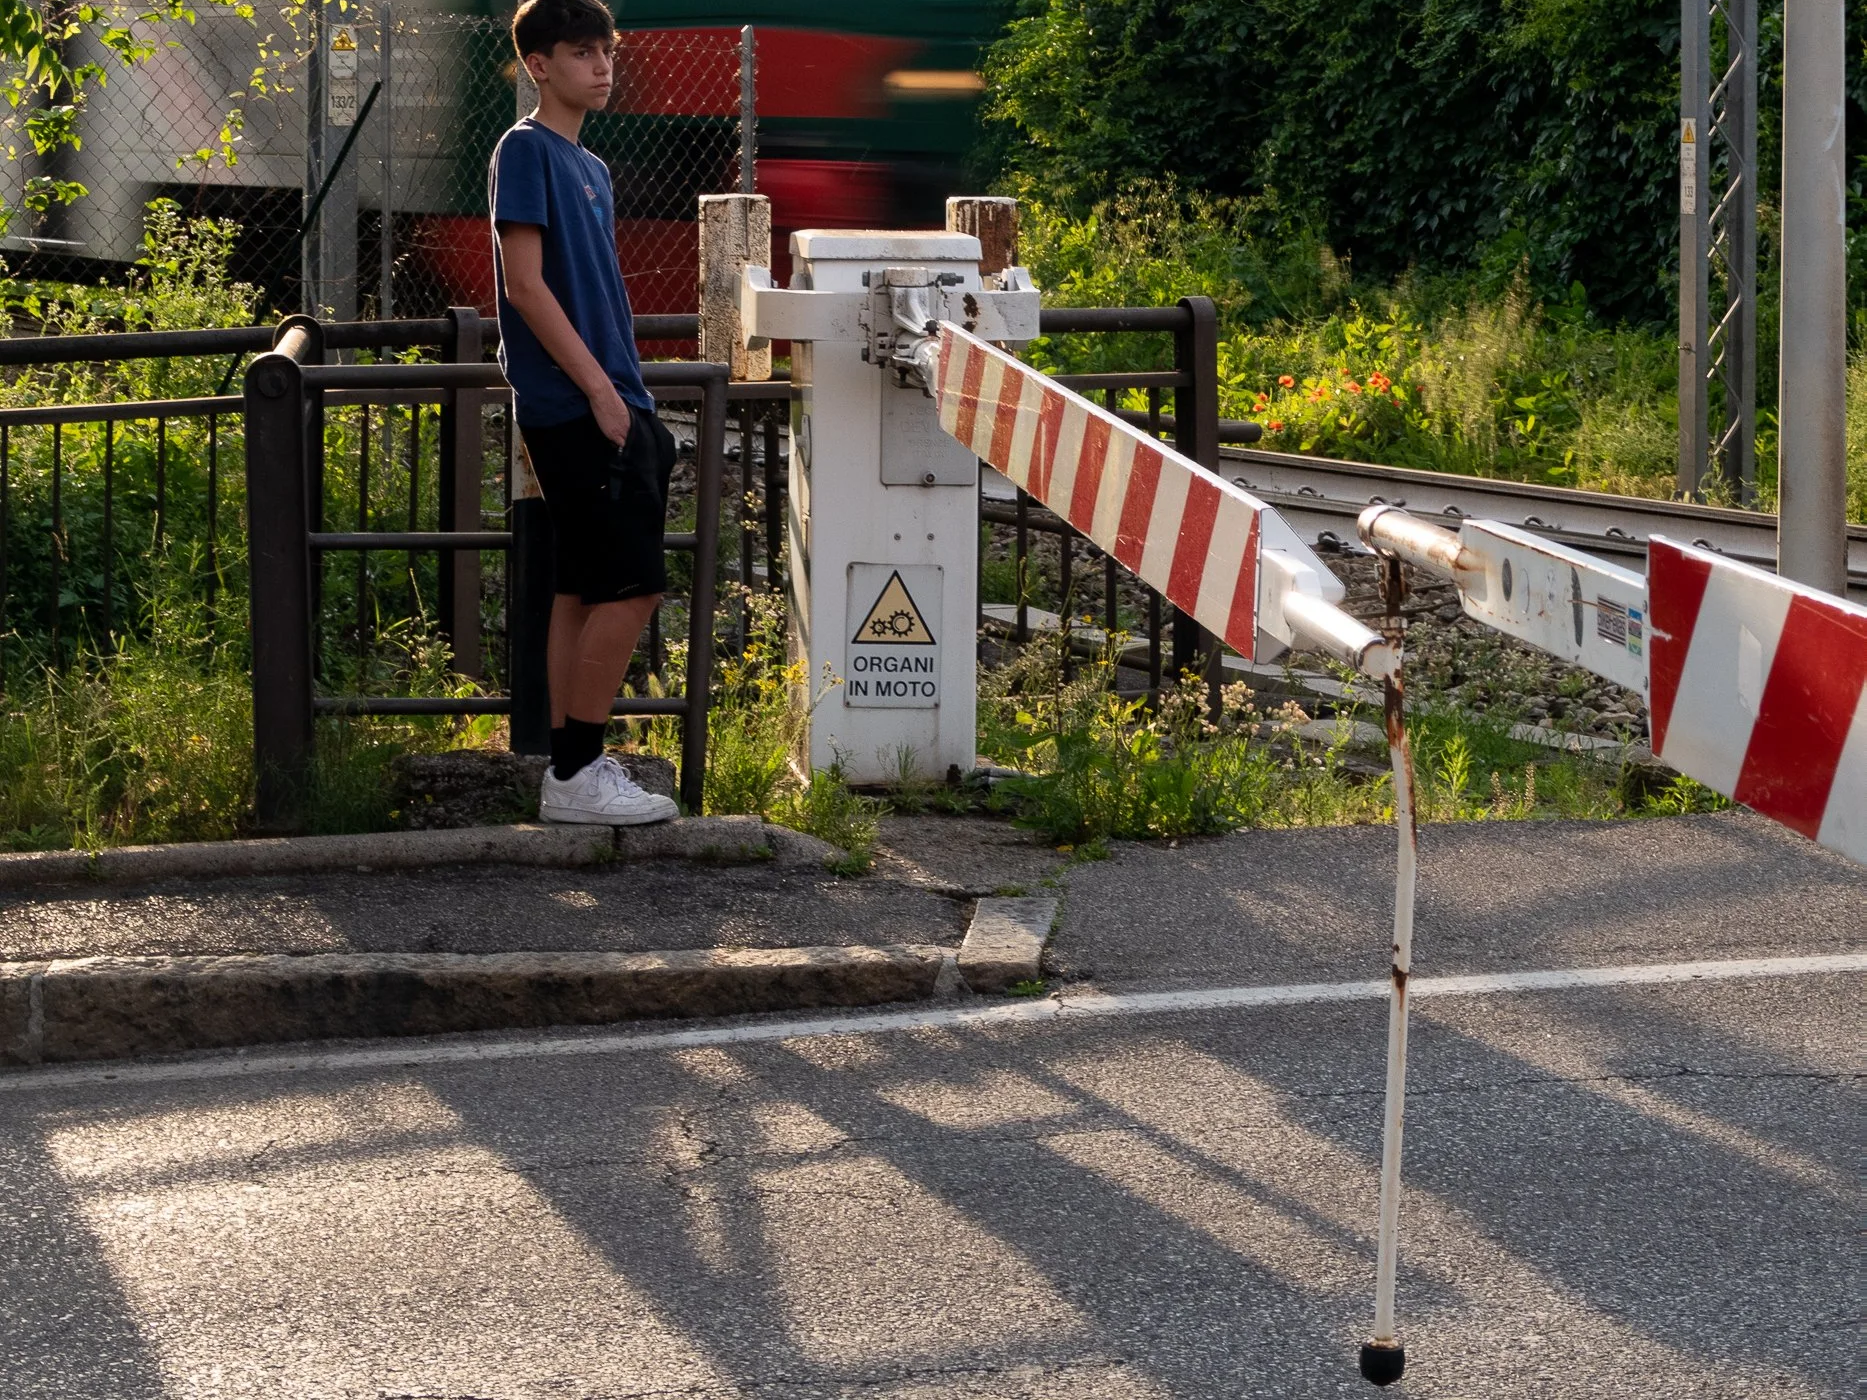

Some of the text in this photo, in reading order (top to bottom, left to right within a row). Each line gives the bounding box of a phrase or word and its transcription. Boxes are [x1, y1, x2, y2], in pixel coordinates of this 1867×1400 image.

[331, 95, 355, 109] 133/2
[853, 655, 934, 673] ORGANI
[849, 680, 936, 698] IN MOTO
